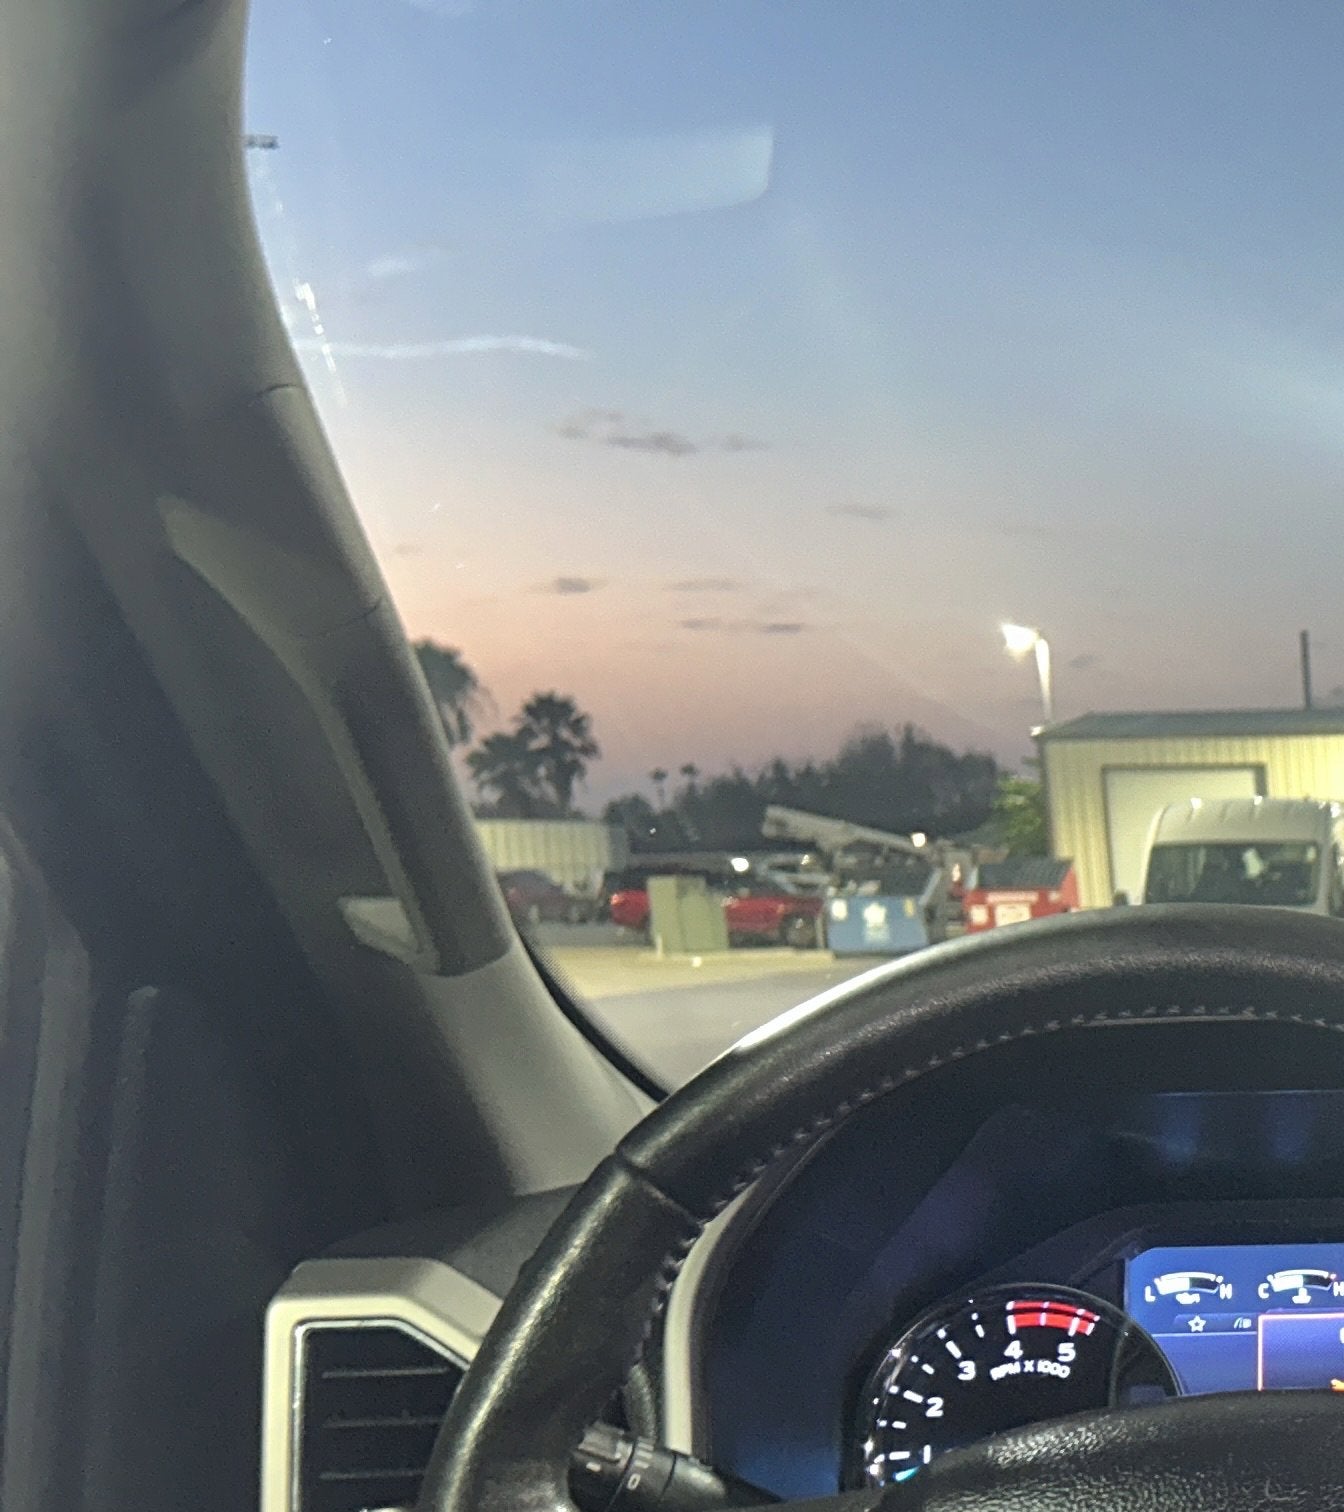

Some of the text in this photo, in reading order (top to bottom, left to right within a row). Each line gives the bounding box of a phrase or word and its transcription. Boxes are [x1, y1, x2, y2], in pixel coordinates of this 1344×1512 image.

[1145, 1286, 1156, 1302] L
[1219, 1284, 1233, 1300] H
[1257, 1284, 1270, 1299] C
[1004, 1340, 1023, 1359] 4
[1057, 1342, 1076, 1362] 5
[957, 1360, 977, 1380] 3
[990, 1359, 1021, 1380] RPM
[1036, 1360, 1071, 1379] 1000
[925, 1396, 944, 1417] 2
